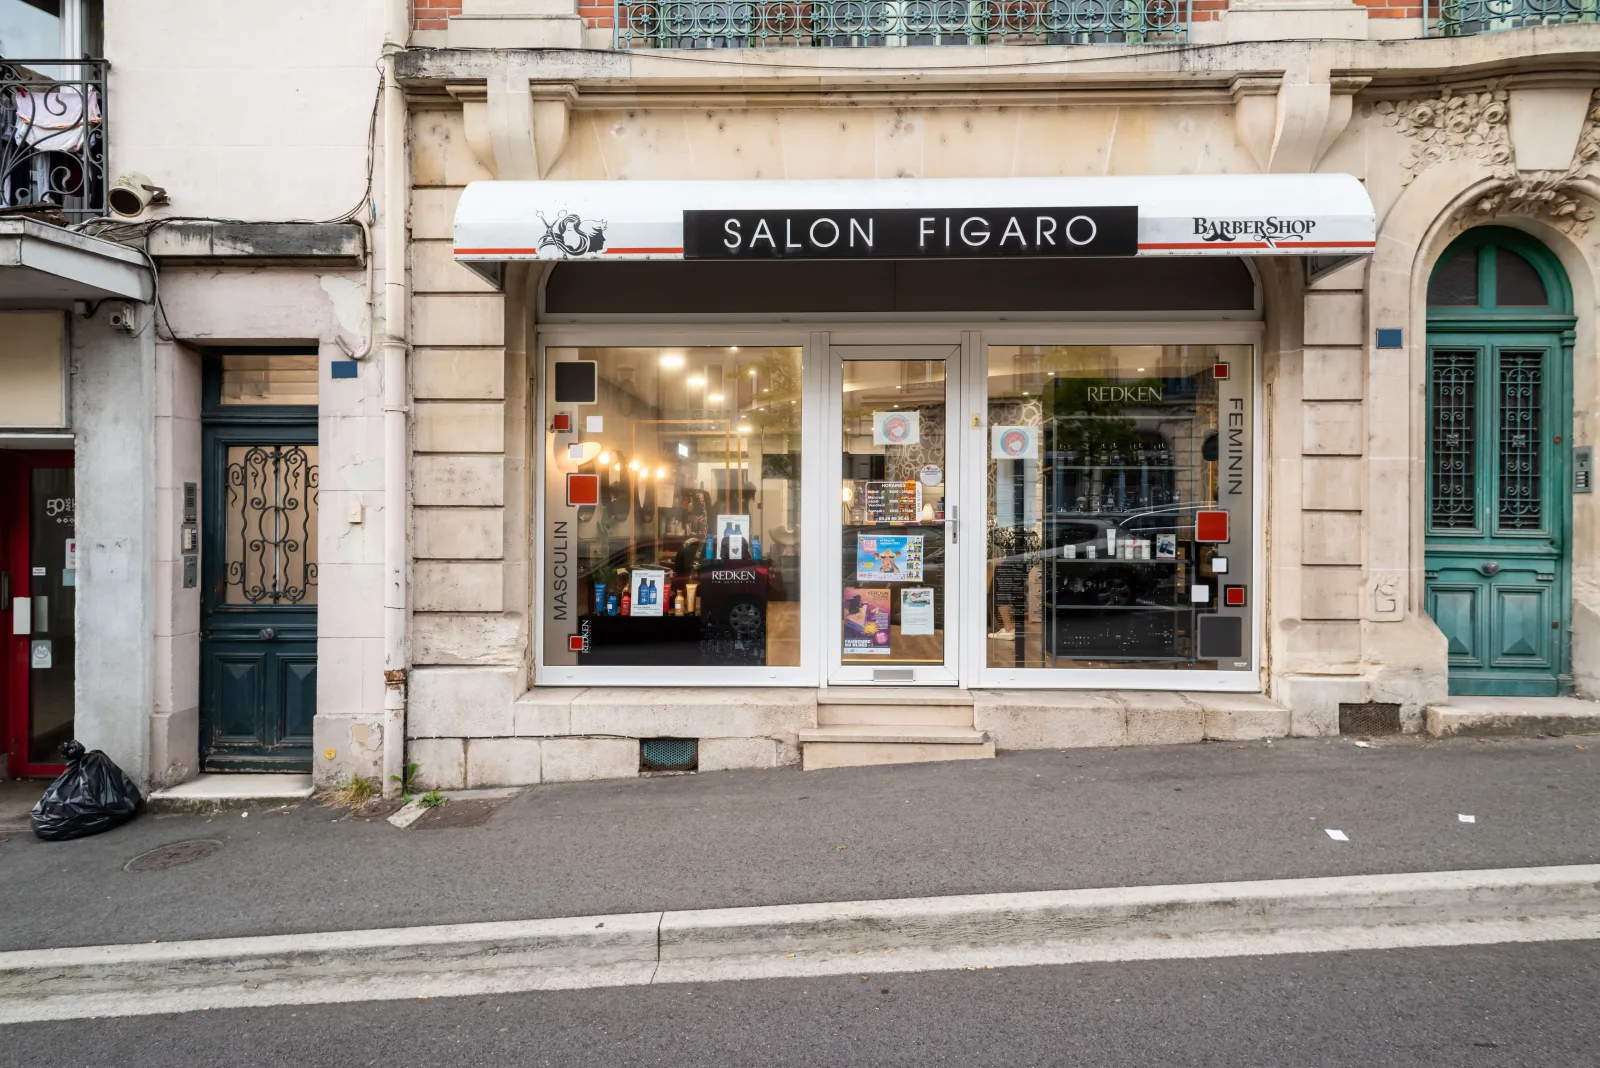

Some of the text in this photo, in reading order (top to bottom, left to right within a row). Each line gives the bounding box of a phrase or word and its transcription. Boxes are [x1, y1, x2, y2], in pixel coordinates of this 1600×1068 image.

[723, 215, 1098, 249] SALON FIGARO
[1192, 216, 1316, 237] BARBERSHOP
[1087, 386, 1163, 402] REDKEN
[1228, 398, 1244, 495] FEMININ
[46, 498, 65, 516] 50
[553, 521, 568, 620] MASCULIN
[711, 570, 756, 580] REDKEN
